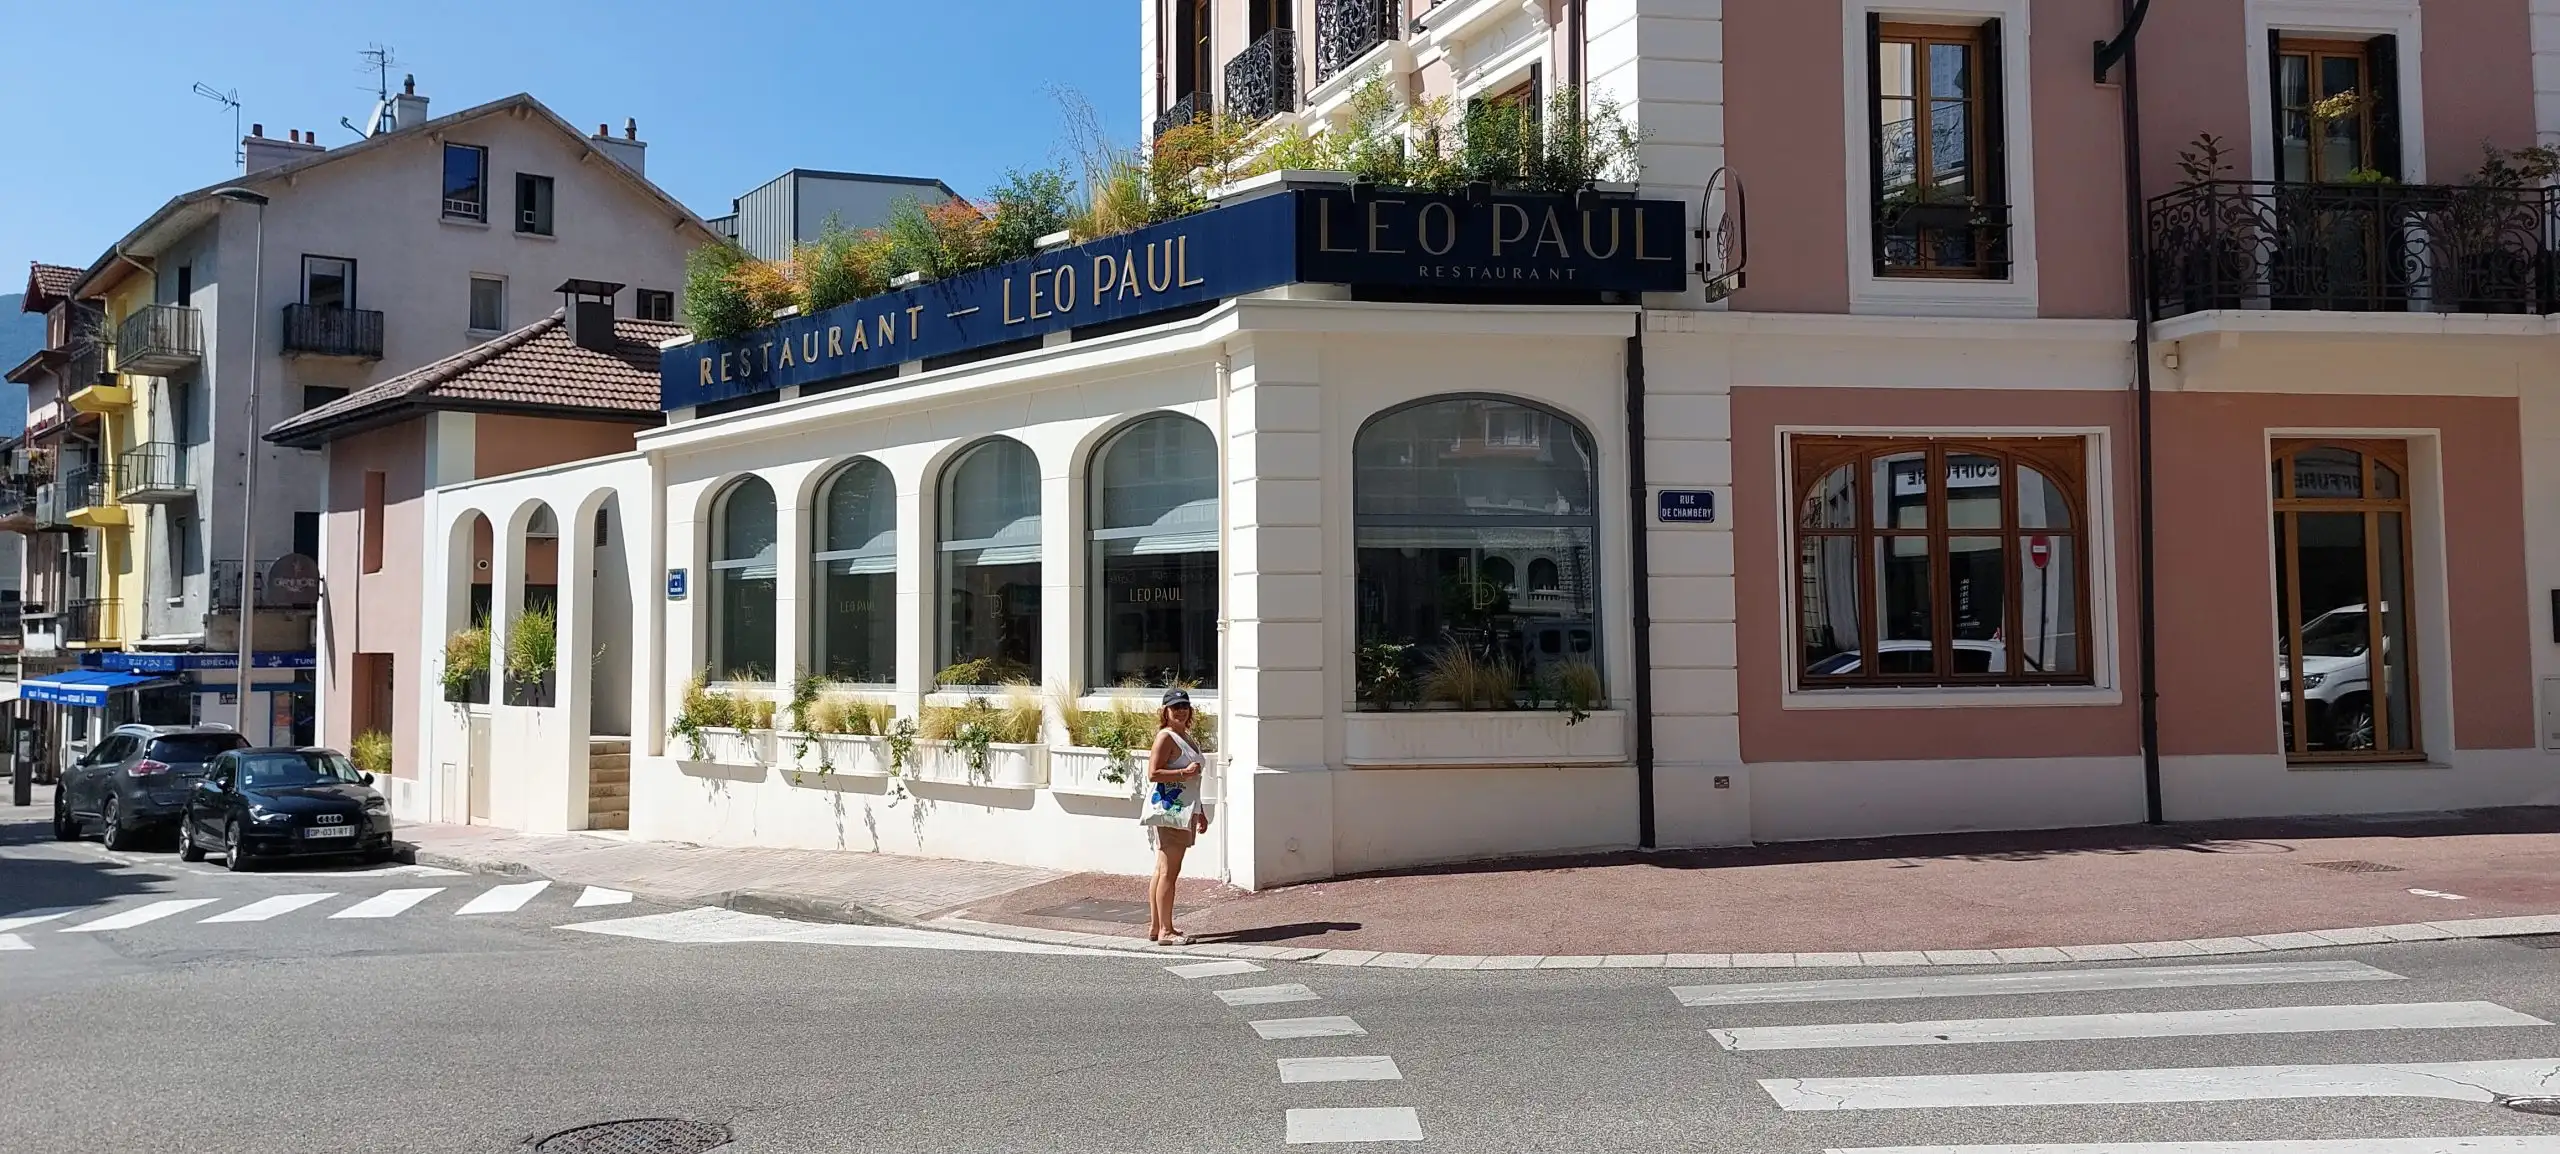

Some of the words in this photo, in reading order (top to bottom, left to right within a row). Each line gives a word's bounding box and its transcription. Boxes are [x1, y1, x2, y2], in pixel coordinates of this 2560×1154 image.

[1320, 196, 1456, 256] LEO
[1492, 202, 1672, 261] PAUL
[1419, 265, 1576, 281] RESTAURANT
[700, 305, 924, 387] RESTAURANT
[1003, 264, 1077, 325] LEO
[1093, 235, 1204, 307] PAUL
[1680, 495, 1695, 504] RUE
[1662, 508, 1672, 517] DE
[1673, 507, 1712, 518] CHAMBÉRY
[1129, 588, 1151, 602] LEO
[1154, 587, 1184, 602] PAUL
[840, 601, 855, 613] LEO
